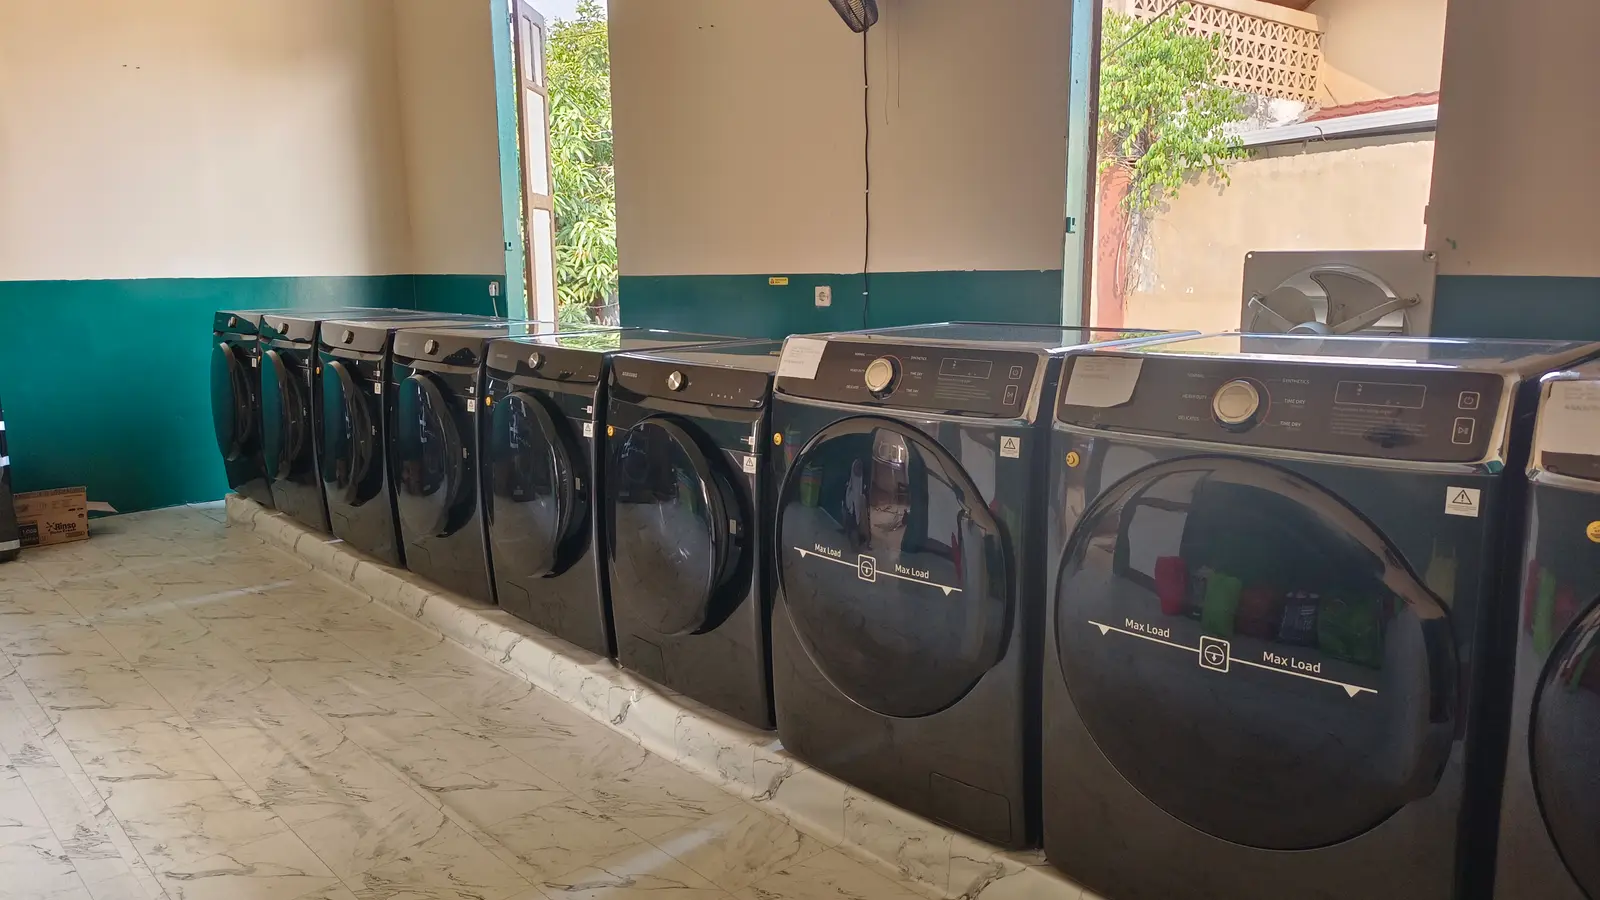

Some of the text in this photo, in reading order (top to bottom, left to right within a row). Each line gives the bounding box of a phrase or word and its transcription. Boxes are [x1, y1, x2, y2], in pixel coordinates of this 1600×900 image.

[55, 522, 76, 530] Rinso
[814, 543, 841, 558] Max Load
[895, 563, 929, 579] Max Load
[1125, 618, 1170, 638] Max Load
[1263, 651, 1321, 673] Max Load
